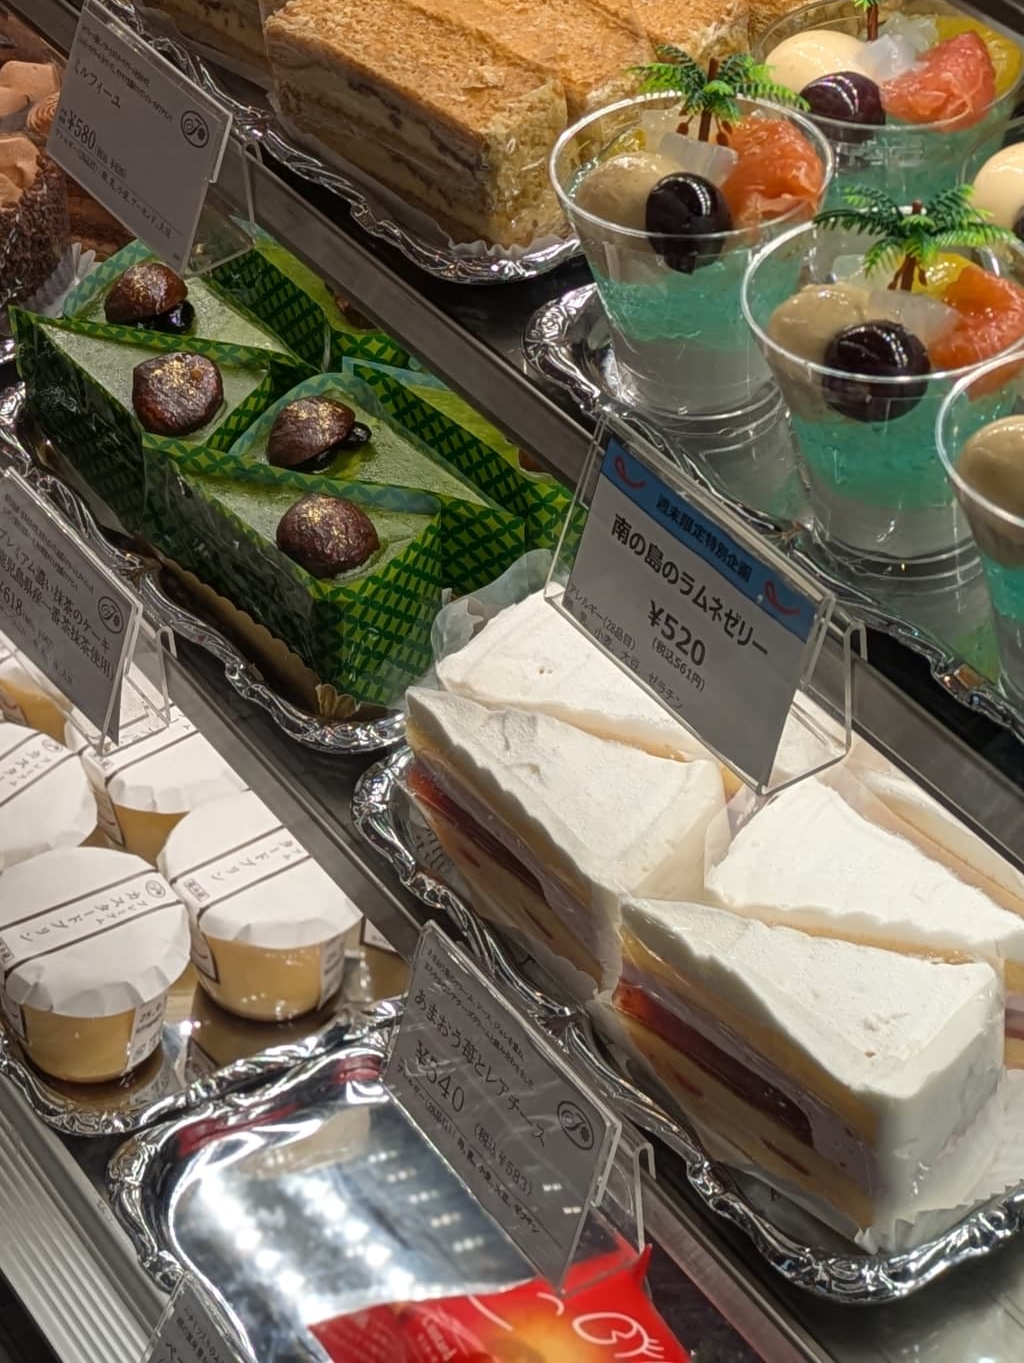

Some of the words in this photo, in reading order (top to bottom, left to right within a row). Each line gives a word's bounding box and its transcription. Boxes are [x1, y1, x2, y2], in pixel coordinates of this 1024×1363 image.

[65, 109, 98, 152] ¥580
[655, 491, 753, 583] 週末限定特別企画
[609, 512, 771, 666] 南の島のラムネゼリー
[645, 598, 708, 669] ¥520
[650, 635, 706, 693] (税込561円)
